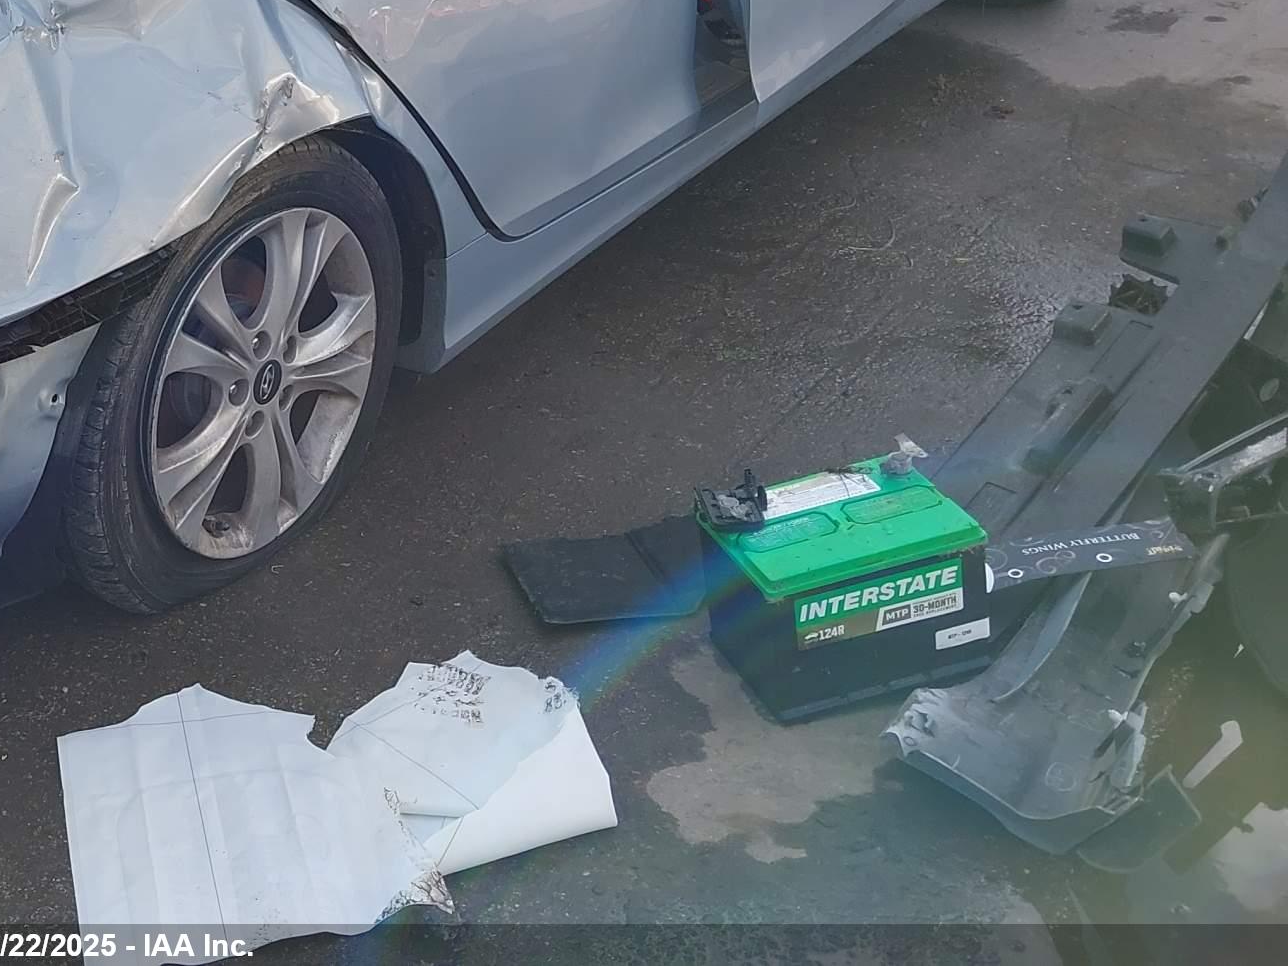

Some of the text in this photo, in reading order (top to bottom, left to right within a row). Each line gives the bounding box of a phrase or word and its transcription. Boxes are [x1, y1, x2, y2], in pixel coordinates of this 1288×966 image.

[1021, 532, 1140, 556] BUTTERFLY WINGS
[799, 565, 959, 623] INTERSTATE
[913, 594, 957, 614] 30-MONTH
[886, 608, 909, 622] MTP
[818, 624, 846, 641] 124R
